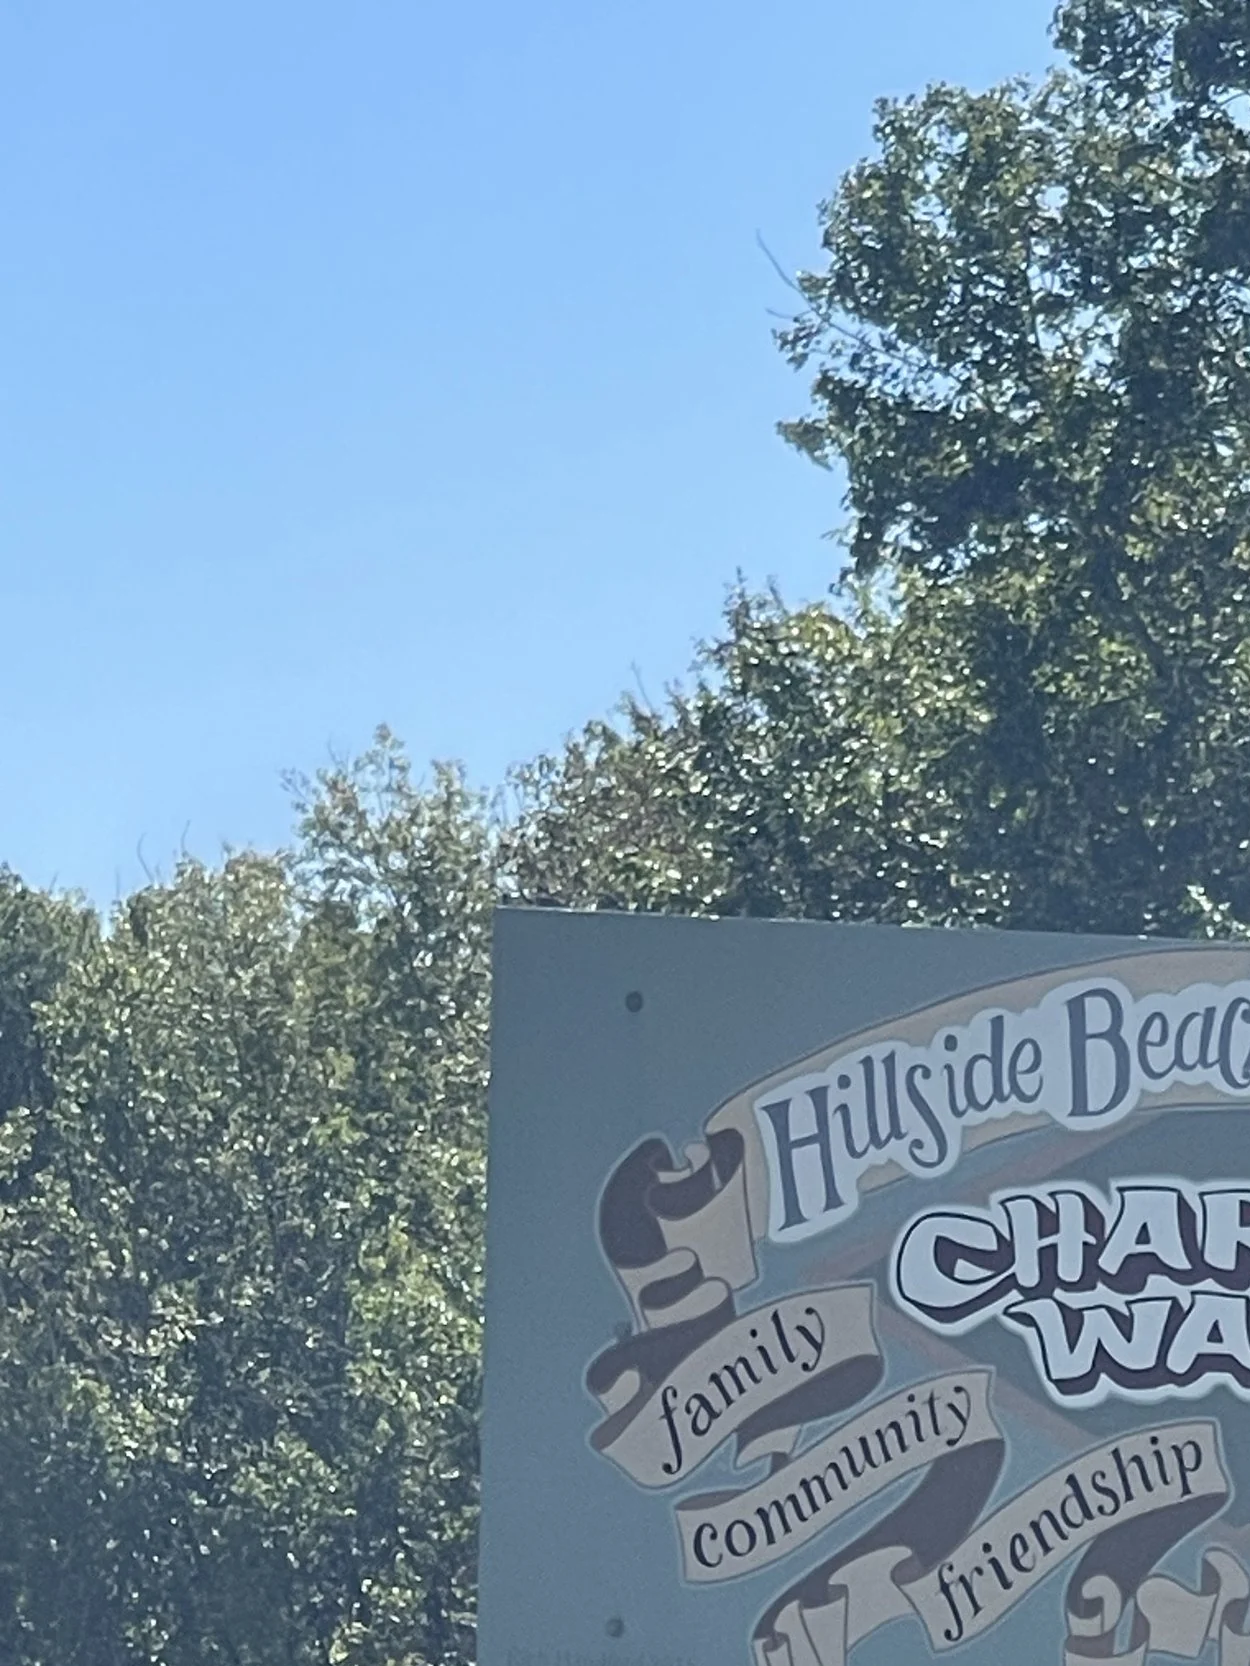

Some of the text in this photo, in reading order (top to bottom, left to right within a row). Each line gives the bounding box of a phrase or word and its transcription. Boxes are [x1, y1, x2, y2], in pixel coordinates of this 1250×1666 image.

[761, 1015, 1045, 1231] Hillside
[660, 1306, 826, 1473] family
[692, 1385, 975, 1569] community
[933, 1435, 1202, 1642] friendship
